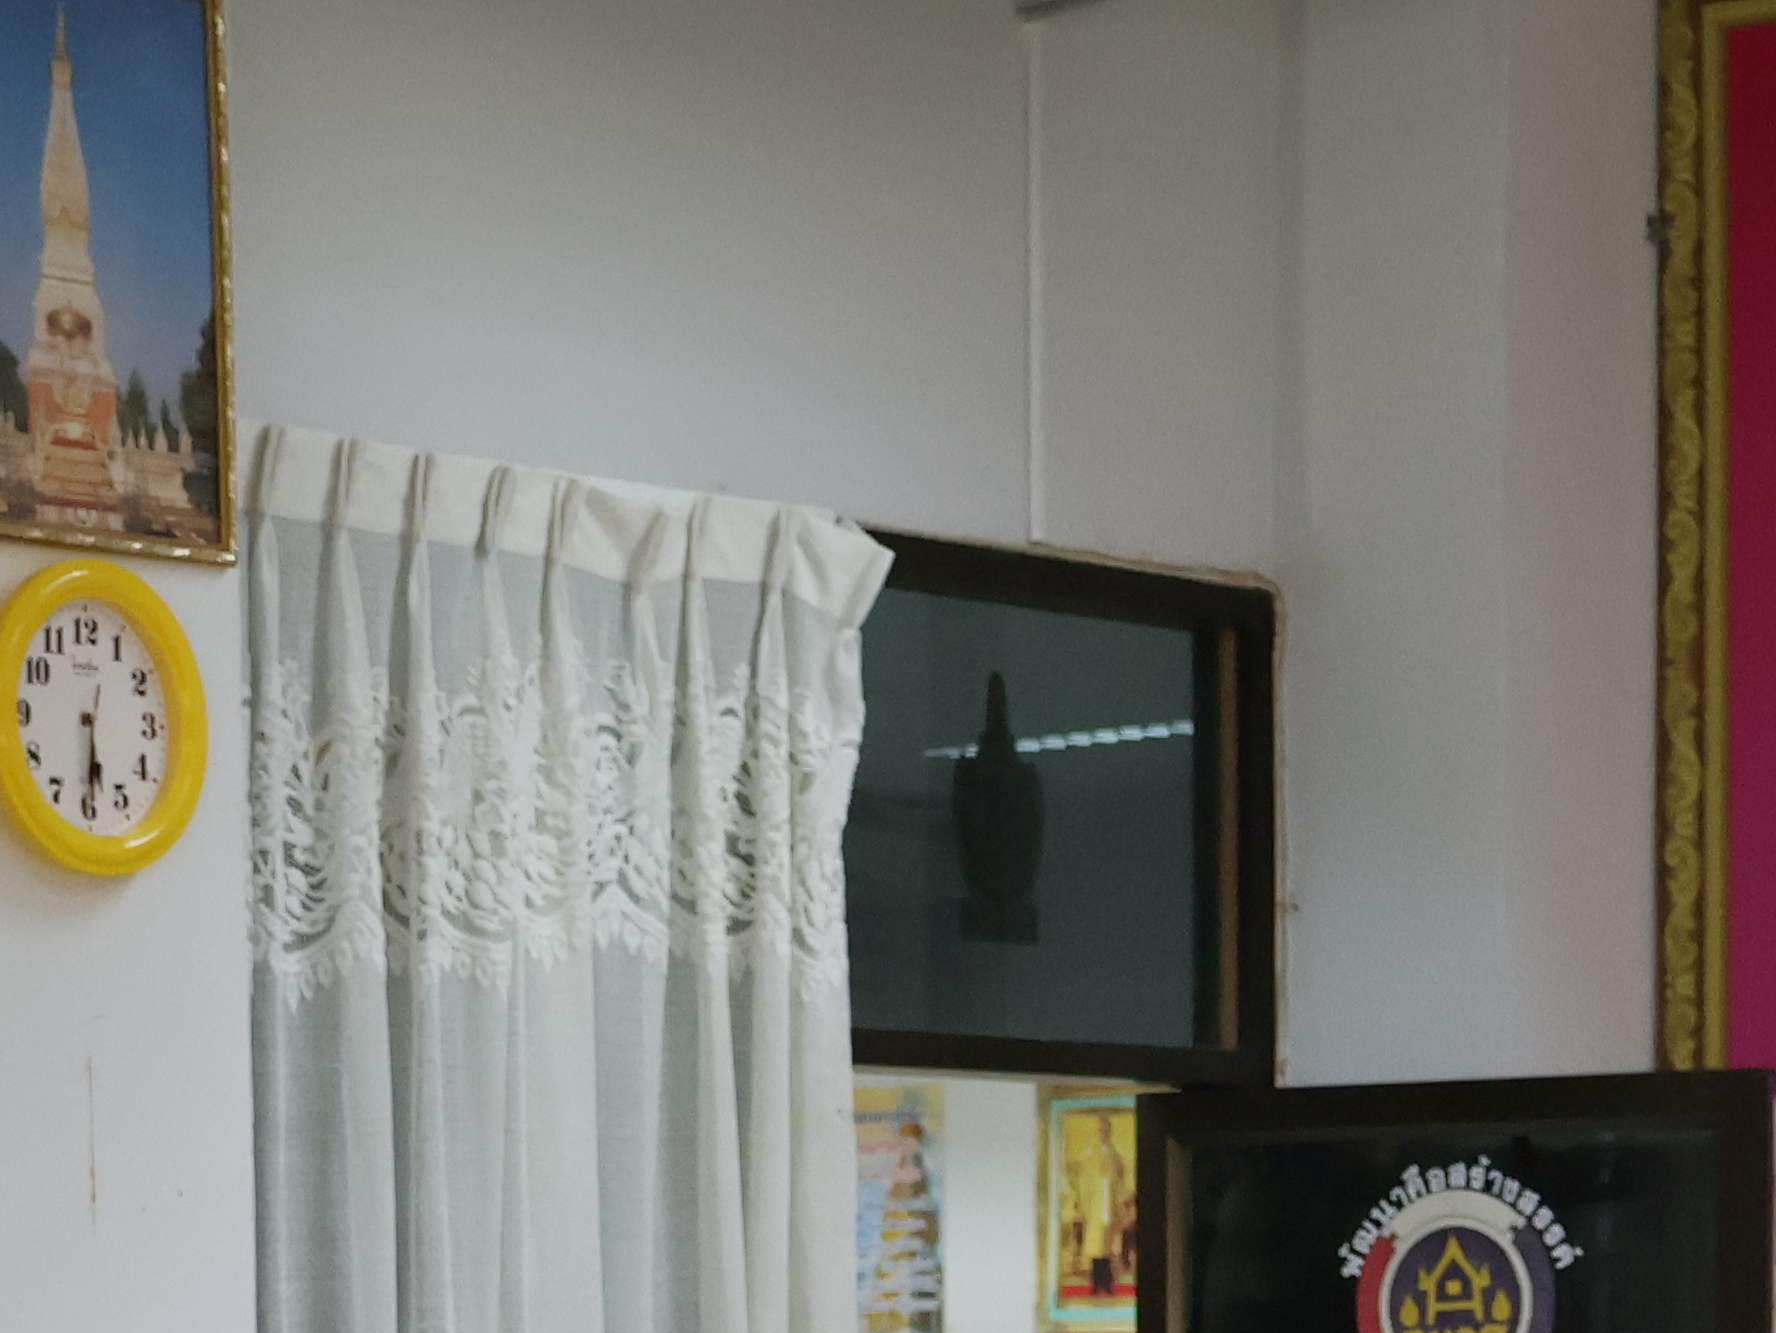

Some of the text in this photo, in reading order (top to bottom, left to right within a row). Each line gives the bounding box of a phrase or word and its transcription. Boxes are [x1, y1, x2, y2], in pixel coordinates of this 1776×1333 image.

[44, 626, 64, 655] 11
[73, 618, 98, 646] 12
[111, 634, 122, 662] 1
[25, 657, 50, 686] 10
[132, 669, 147, 696] 2
[17, 700, 31, 726] 9
[142, 712, 157, 740] 3
[134, 754, 148, 781] 4
[49, 776, 65, 804] 7
[114, 783, 129, 811] 5
[81, 795, 97, 821] 6
